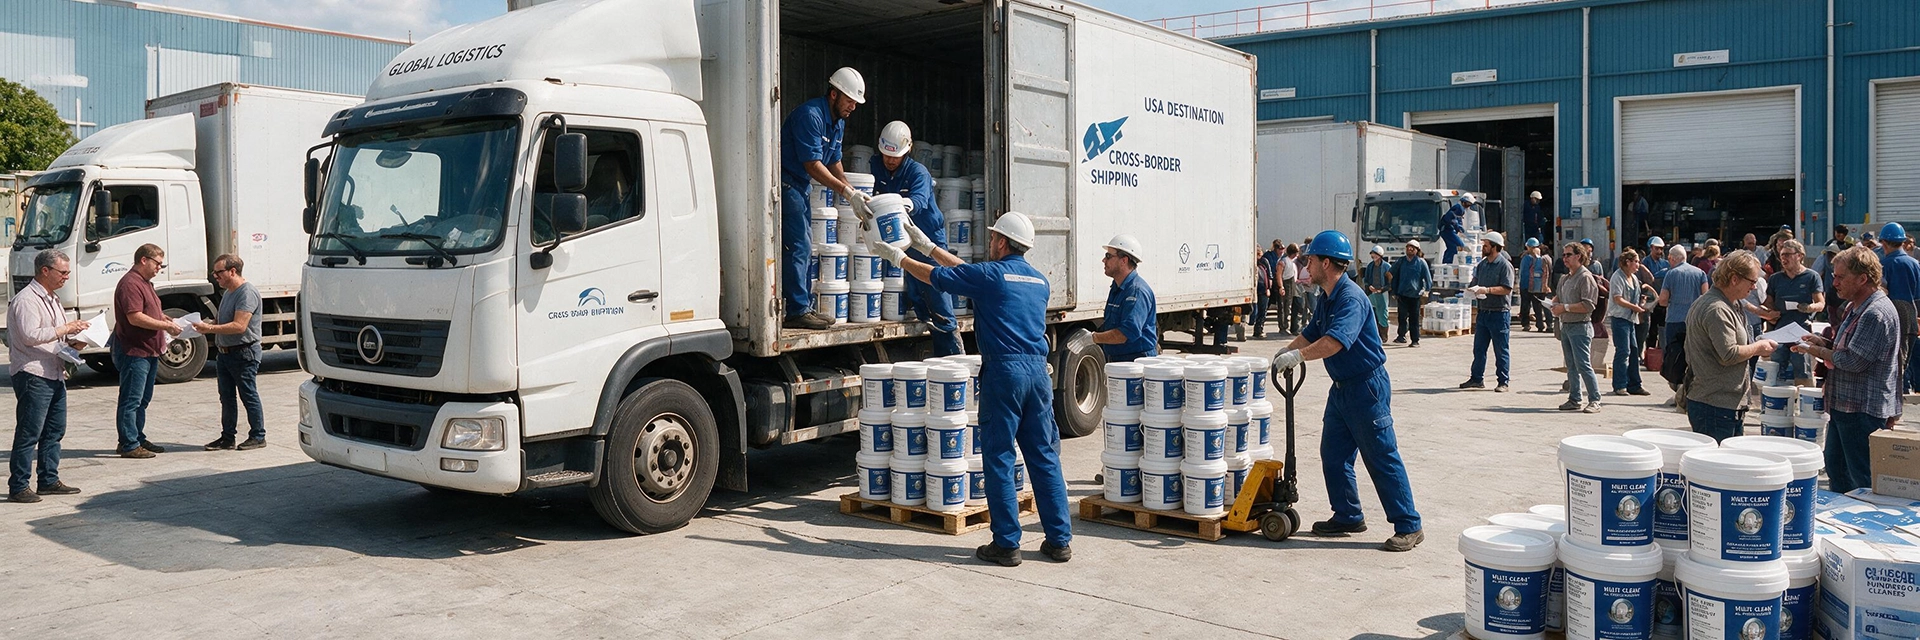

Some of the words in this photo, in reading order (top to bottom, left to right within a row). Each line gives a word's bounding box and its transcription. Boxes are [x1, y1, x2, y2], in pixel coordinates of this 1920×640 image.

[388, 56, 436, 76] GLOBAL
[437, 44, 506, 67] LOGISTICS
[1144, 96, 1165, 115] USA
[1167, 102, 1224, 125] DESTINATION
[1108, 149, 1182, 173] CROSS-BORDER
[1090, 168, 1139, 188] SHIPPING
